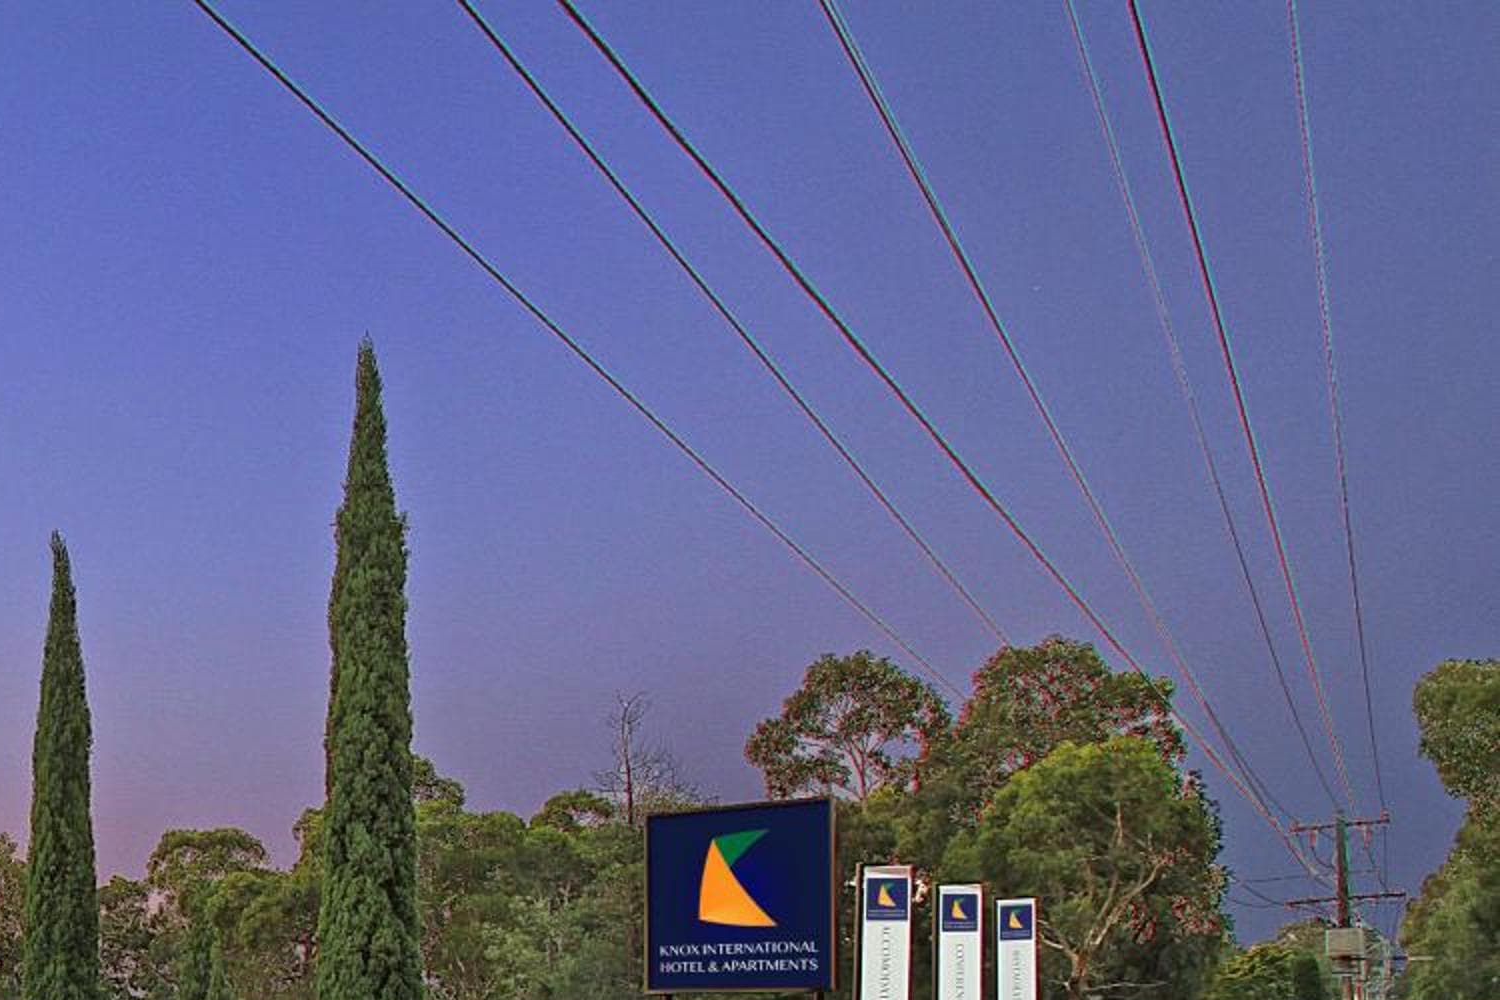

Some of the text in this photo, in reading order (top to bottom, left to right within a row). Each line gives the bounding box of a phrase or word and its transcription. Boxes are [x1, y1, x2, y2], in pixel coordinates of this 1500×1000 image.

[659, 940, 819, 957] KNOX INTERNATIONAL
[659, 958, 819, 973] HOTEL & APARTMENTS
